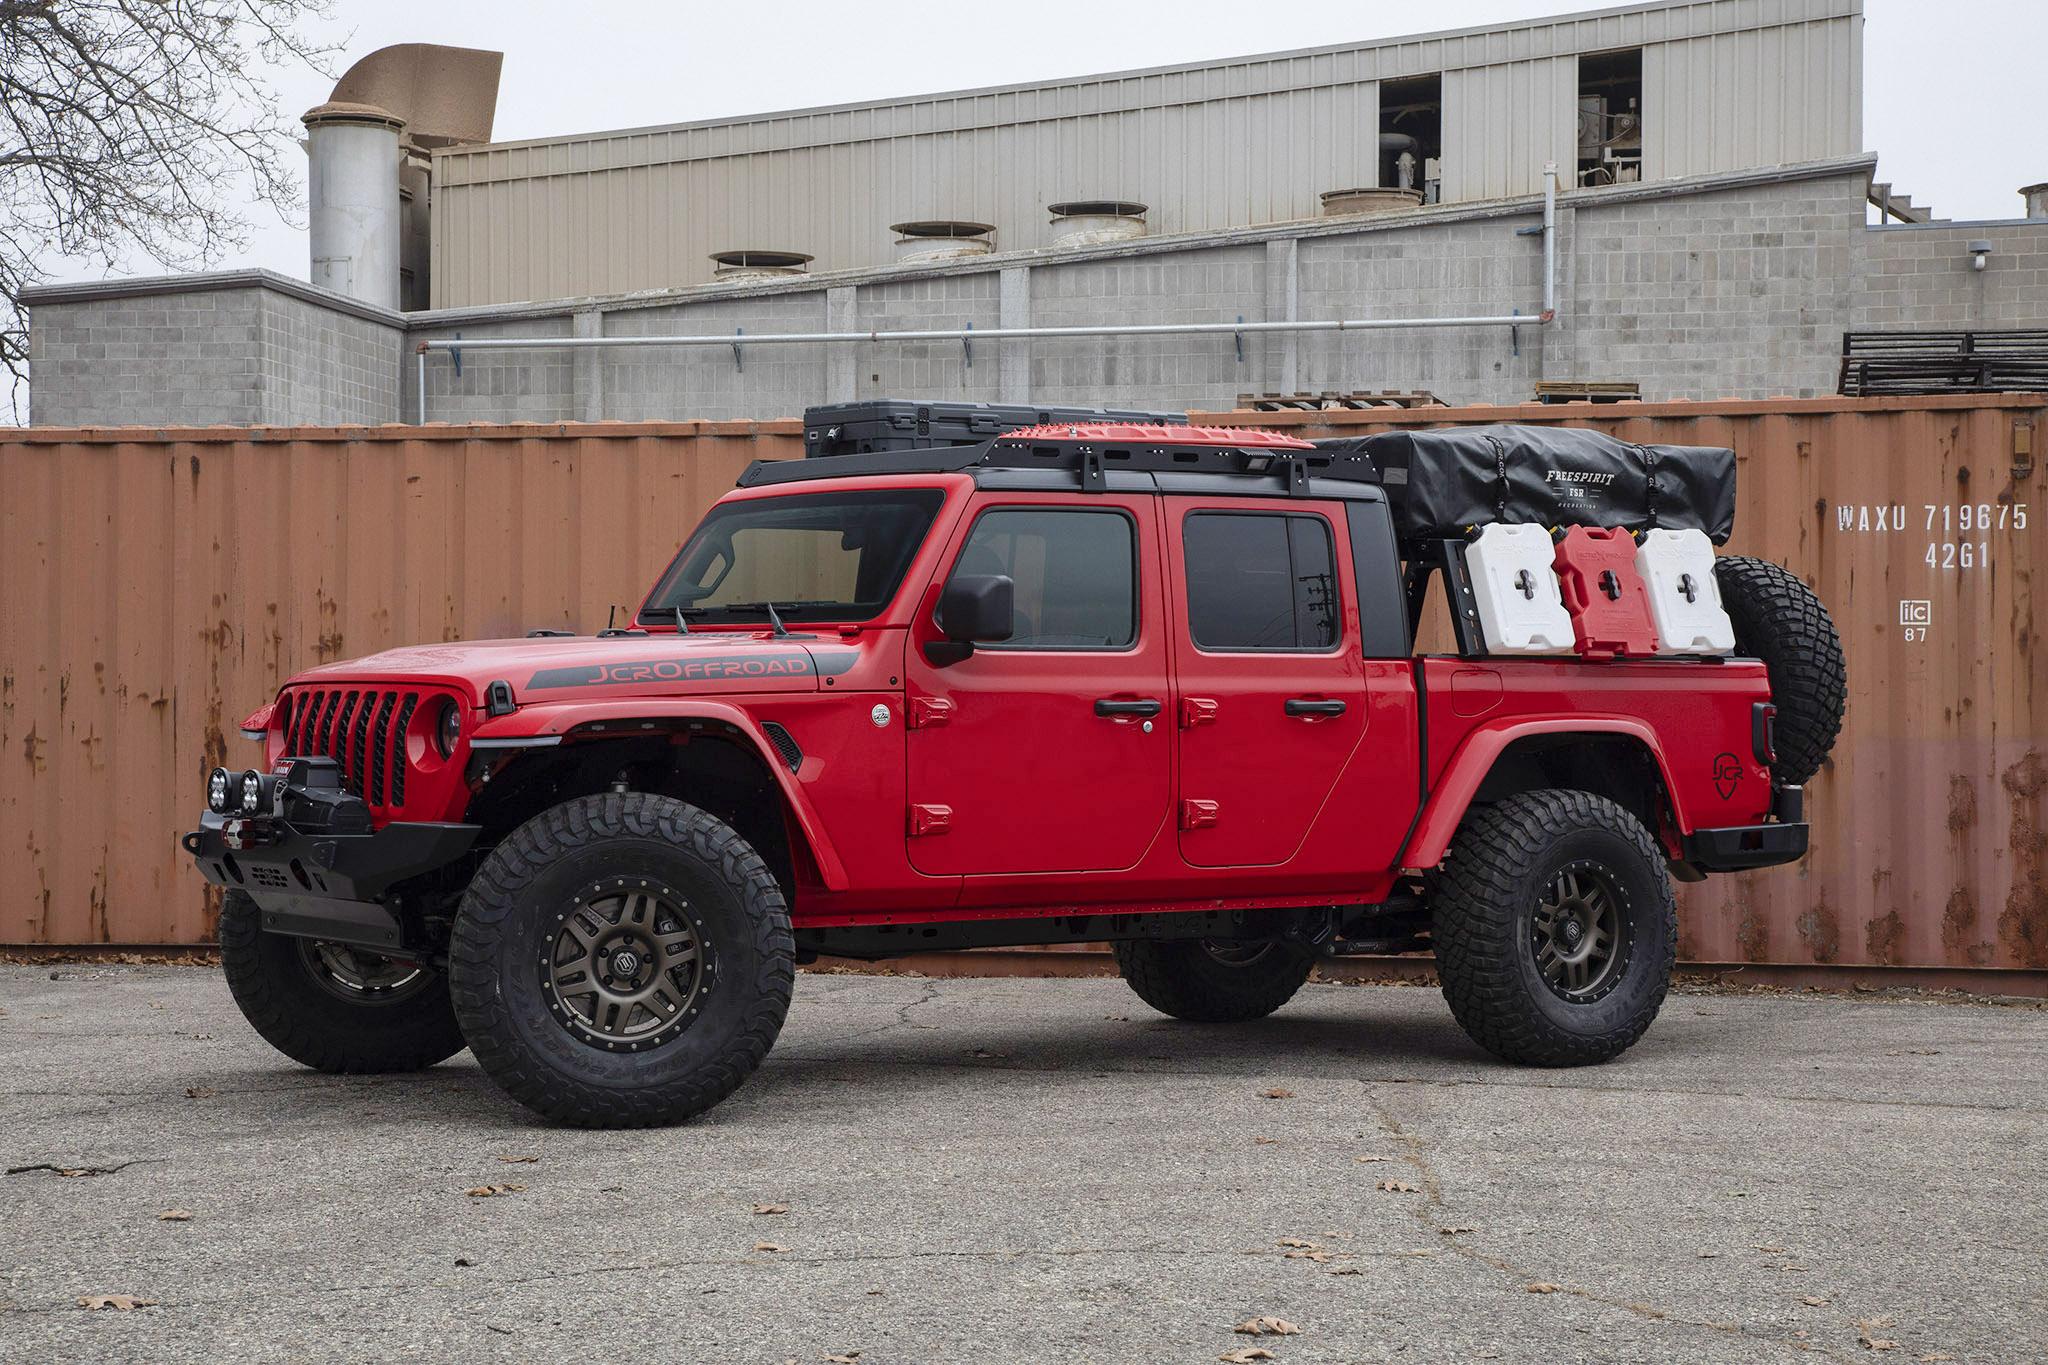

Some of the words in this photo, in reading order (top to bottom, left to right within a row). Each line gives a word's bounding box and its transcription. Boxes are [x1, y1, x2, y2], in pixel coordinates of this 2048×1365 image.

[1545, 470, 1614, 486] FREESPIRIT
[1569, 487, 1585, 498] FSR
[1837, 504, 1906, 531] WAXU
[1924, 503, 2027, 530] 719675
[1925, 541, 1988, 569] 42G1
[1904, 628, 1926, 642] 87
